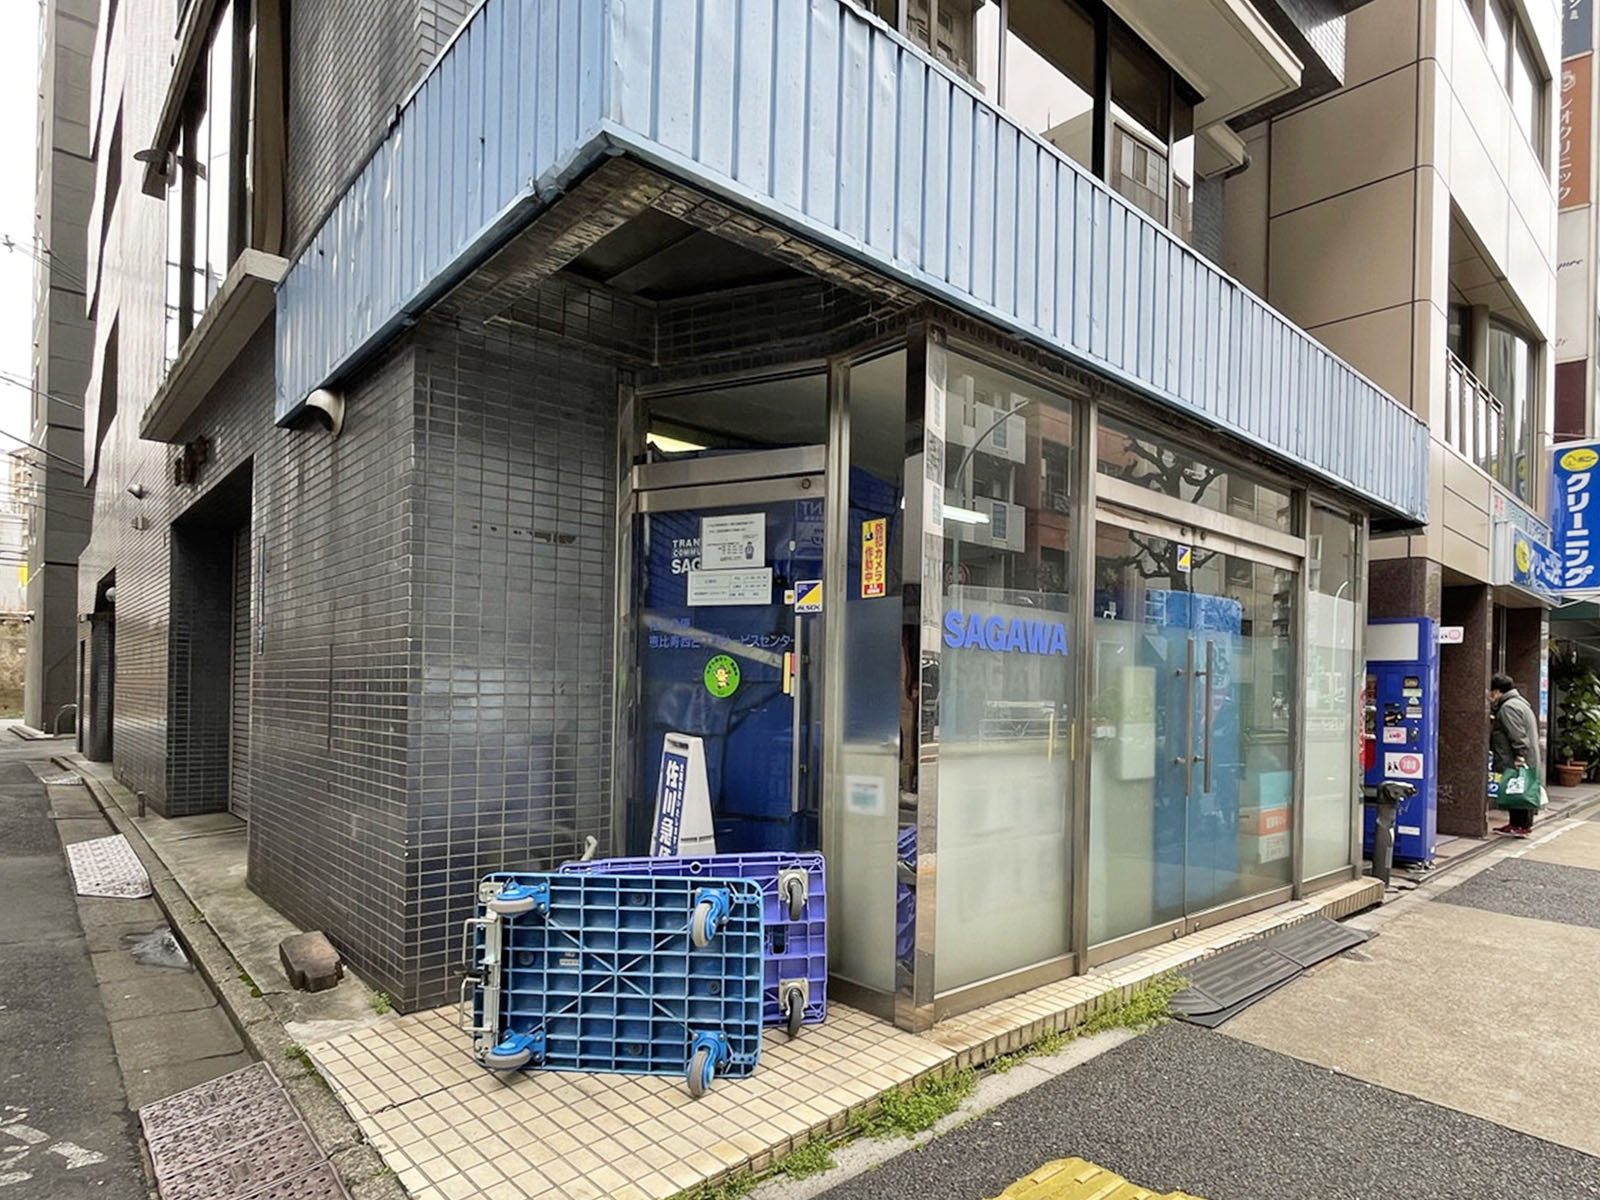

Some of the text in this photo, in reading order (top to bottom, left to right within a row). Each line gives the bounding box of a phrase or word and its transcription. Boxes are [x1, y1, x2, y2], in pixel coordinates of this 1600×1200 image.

[1565, 472, 1595, 587] クリーニング
[943, 609, 1068, 656] SAGAWA
